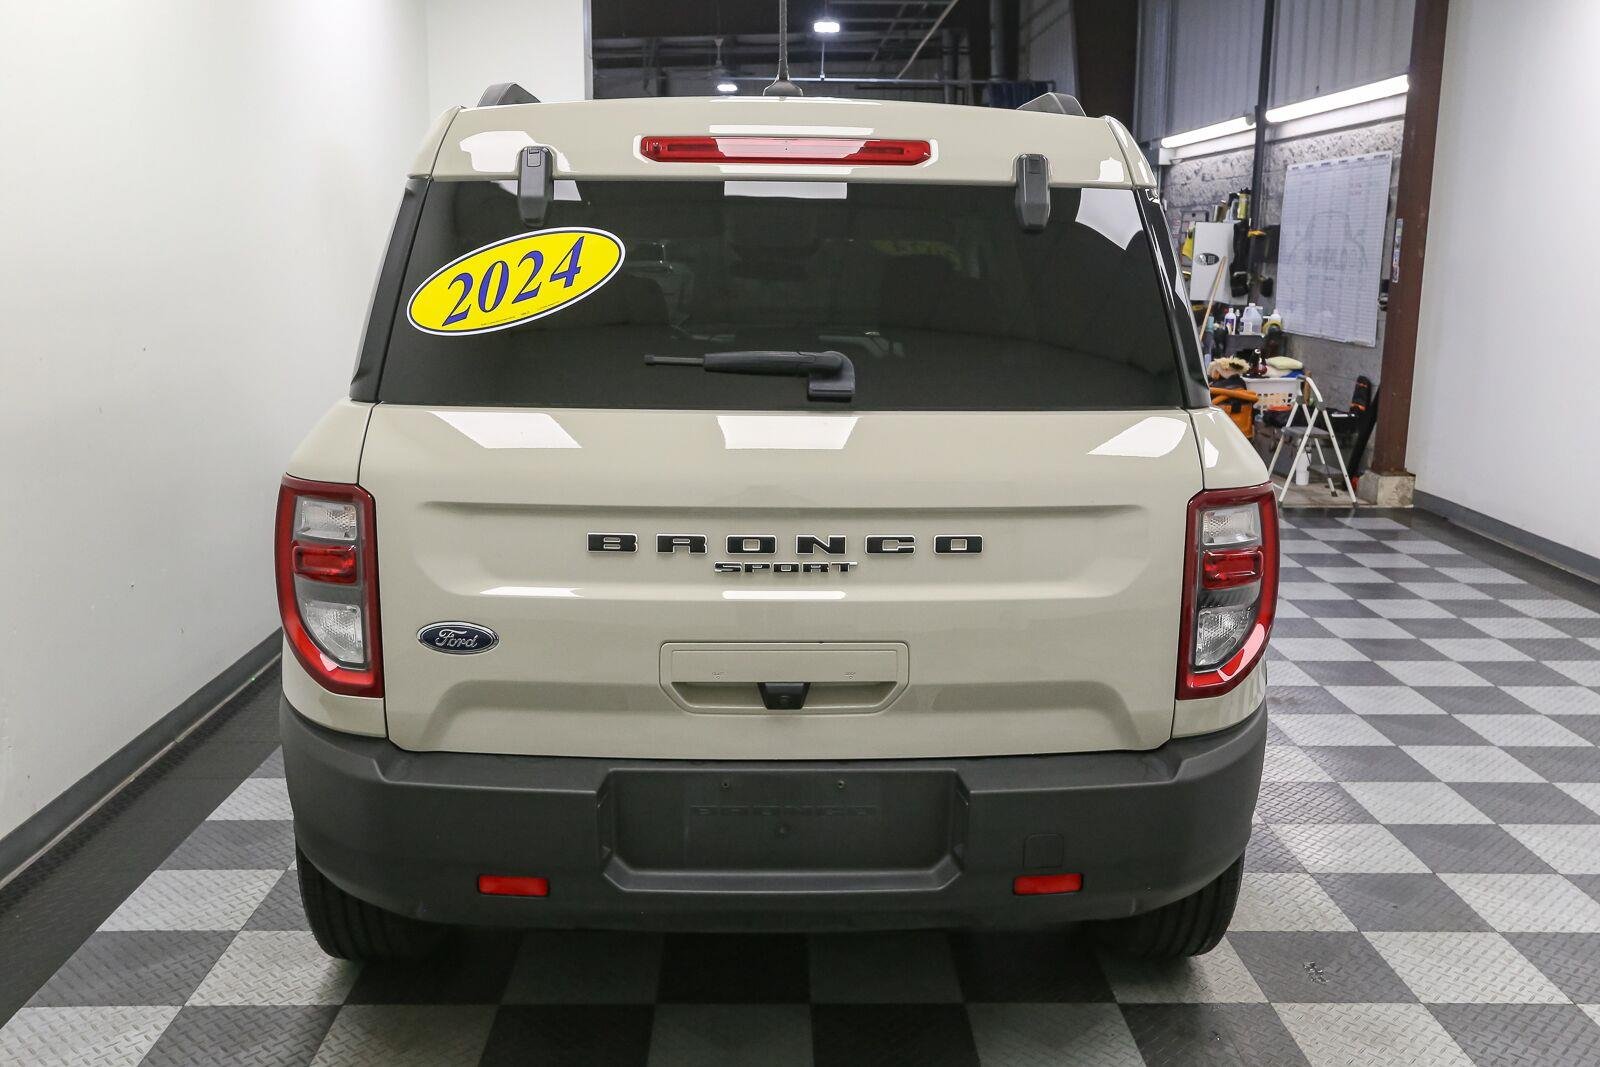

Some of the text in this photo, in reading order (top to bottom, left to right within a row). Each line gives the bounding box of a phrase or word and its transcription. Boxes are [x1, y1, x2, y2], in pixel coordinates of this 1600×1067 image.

[441, 235, 585, 327] 2024
[586, 532, 984, 555] BRONCO
[713, 561, 858, 574] SPORT
[434, 628, 479, 648] Ford
